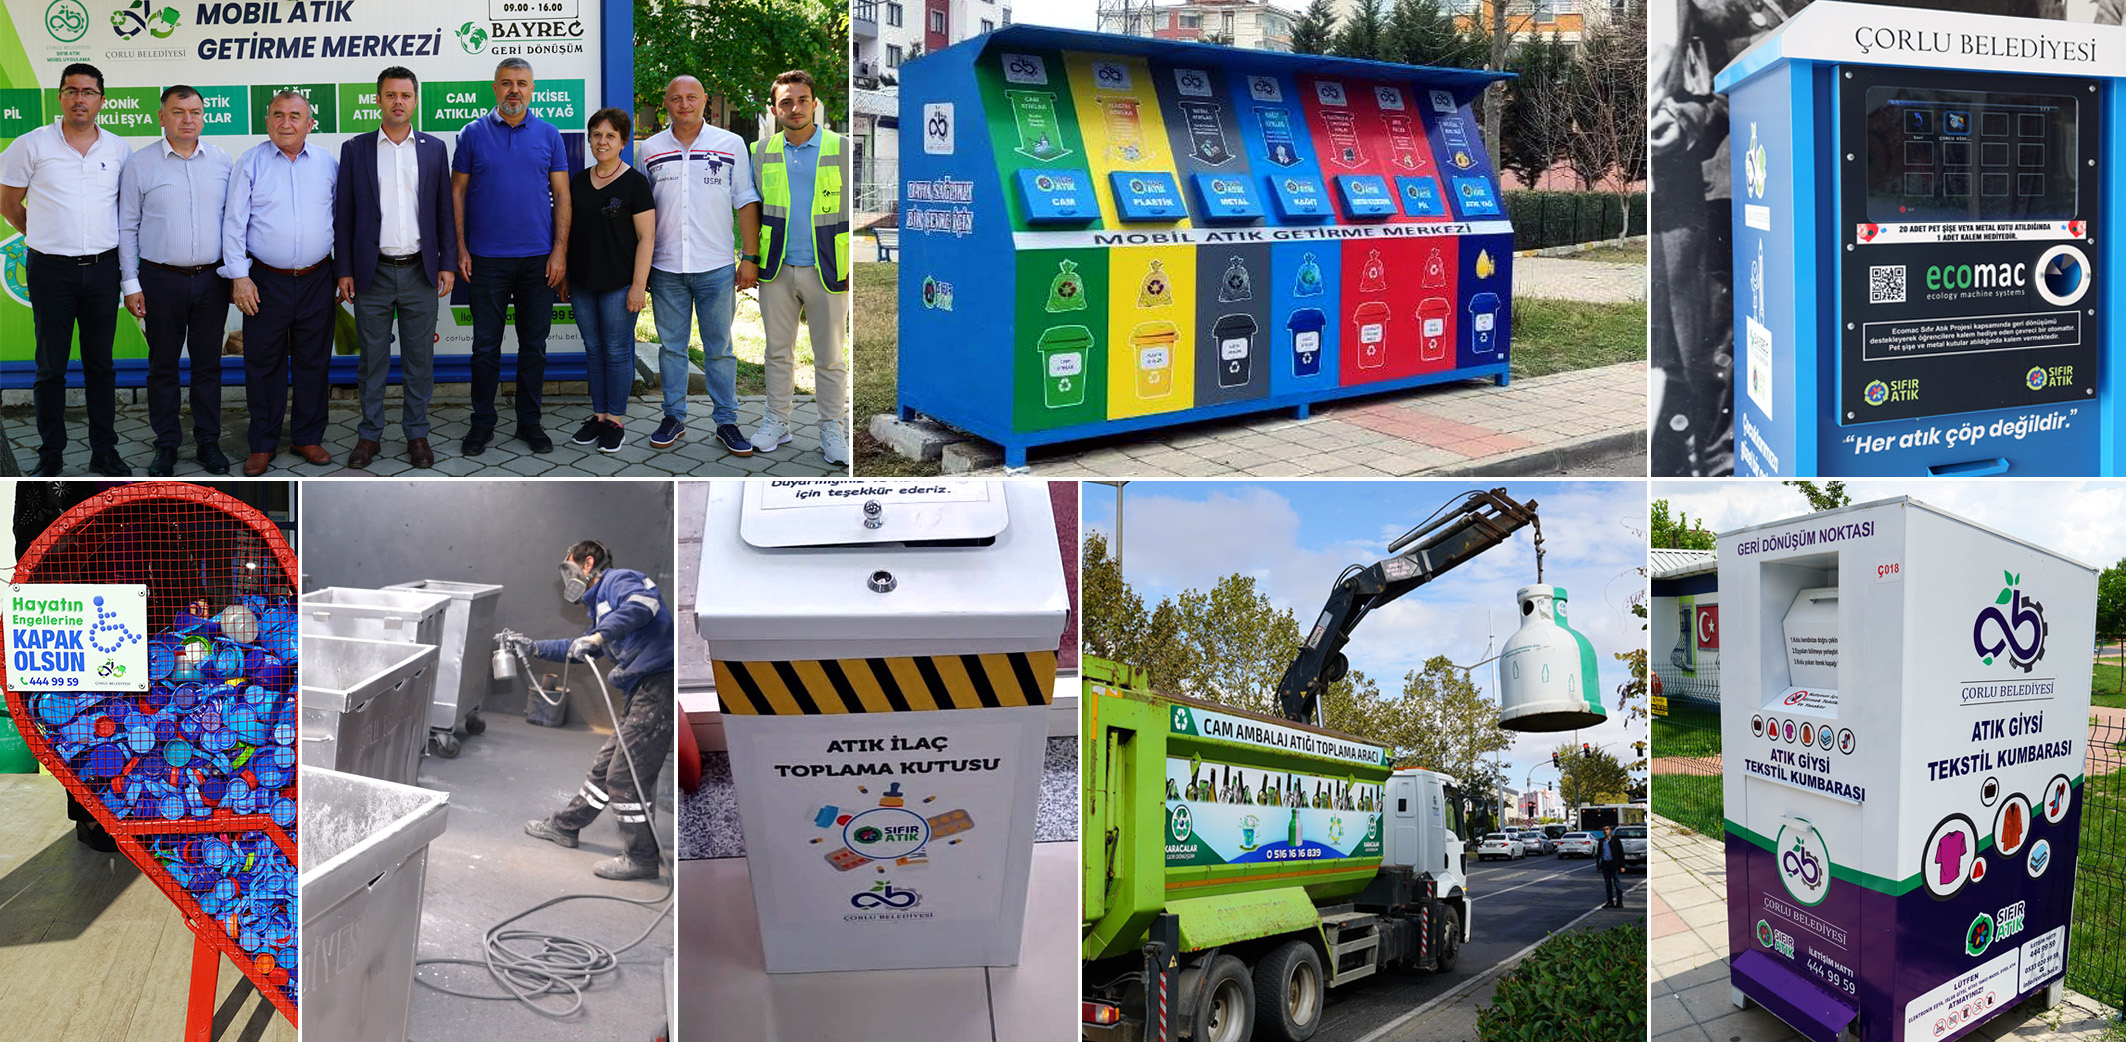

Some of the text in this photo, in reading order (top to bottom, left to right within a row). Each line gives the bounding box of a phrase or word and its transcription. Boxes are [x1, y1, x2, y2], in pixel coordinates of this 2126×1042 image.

[195, 0, 356, 24] MOBİL ATIK
[503, 3, 529, 12] 09.00
[538, 3, 563, 12] 16.00
[491, 20, 585, 38] BAYREC
[197, 28, 441, 60] GETİRME MERKEZİ
[491, 43, 583, 55] GERİ DÖNÜŞÜM
[1854, 26, 2098, 63] ÇORLU BELEDİYESİ
[105, 49, 186, 60] ÇORLU BELEDİYESİ
[446, 93, 477, 104] CAM
[4, 107, 22, 119] PİL
[435, 107, 489, 120] ATIKLAR
[546, 103, 574, 118] YAĞ
[123, 114, 153, 128] EŞYA
[1094, 231, 1195, 245] MOBİL
[1206, 230, 1262, 243] ATIK
[1273, 225, 1376, 240] GETİRME
[1899, 222, 2051, 234] 20 ADET PET ŞİŞE VEYA METAL KUTU ATILDIĞINDA
[1942, 233, 1959, 241] ADET
[1960, 232, 1982, 241] KALEM
[1983, 231, 2018, 241] HEDİYEDİR.
[1926, 261, 2026, 290] ecomac
[1926, 287, 2026, 301] ecology machine systems
[1892, 326, 1919, 335] Ecomac
[1949, 322, 1973, 333] Projesi
[2012, 319, 2026, 329] geri
[1918, 331, 1955, 343] öğrencilere
[1956, 330, 1976, 339] kalem
[1976, 328, 1997, 339] hediye
[1998, 328, 2014, 336] eden
[2038, 325, 2046, 333] bir
[1888, 342, 1901, 351] Pet
[1901, 342, 1916, 351] şişe
[1917, 342, 1925, 350] ve
[1926, 340, 1945, 349] metal
[1946, 338, 1968, 347] kutular
[2004, 334, 2022, 343] kalem
[2048, 365, 2073, 377] SIFIR
[1890, 378, 1920, 391] SIFIR
[2049, 375, 2073, 387] ATIK
[1890, 388, 1920, 402] ATIK
[1898, 426, 1941, 449] atık
[1945, 422, 1985, 448] çöp
[795, 485, 952, 500] için teşekkür ederiz.
[1737, 520, 1875, 556] GERİ DÖNÜŞÜM NOKTASI
[1877, 562, 1900, 579] Ç018
[12, 597, 84, 615] Hayatın
[12, 615, 84, 627] Engellerine
[13, 629, 85, 650] KAPAK
[14, 650, 85, 672] OLSUN
[29, 677, 79, 687] 444 99 59
[1961, 681, 2055, 703] ÇORLU BELEDİYESİ
[1971, 710, 2044, 742] ATIK GİYSİ
[826, 735, 949, 754] ATIK İLAÇ
[1203, 717, 1379, 763] CAM AMBALAJ ATIĞI TOPLAMA ARACI
[774, 758, 1002, 778] TOPLAMA KUTUSU
[1770, 748, 1831, 774] ATIK GİYSİ
[1927, 739, 2073, 782] TEKSTİL KUMBARASI
[1744, 758, 1866, 802] TEKSTİL KUMBARASI
[884, 825, 920, 835] SIFIR
[885, 833, 920, 842] ATIK
[1274, 850, 1287, 859] 516
[1288, 849, 1297, 859] 16
[1298, 849, 1306, 858] 16
[1306, 848, 1321, 858] 839
[843, 912, 934, 922] ÇORLU BELEDİYESİ
[1763, 897, 1847, 945] ÇORLU BELEDİYESİ
[1997, 901, 2026, 925] SIFIR
[1774, 929, 1795, 948] SIFIR
[1996, 919, 2025, 942] ATIK
[1774, 938, 1795, 961] ATIK
[2030, 947, 2041, 958] 444
[1808, 945, 1854, 979] İLETİŞİM HATTI
[1807, 958, 1856, 996] 444 99 59
[1953, 972, 1980, 991] LÜTFEN
[1948, 986, 1985, 1011] ATMAYINIZ!
